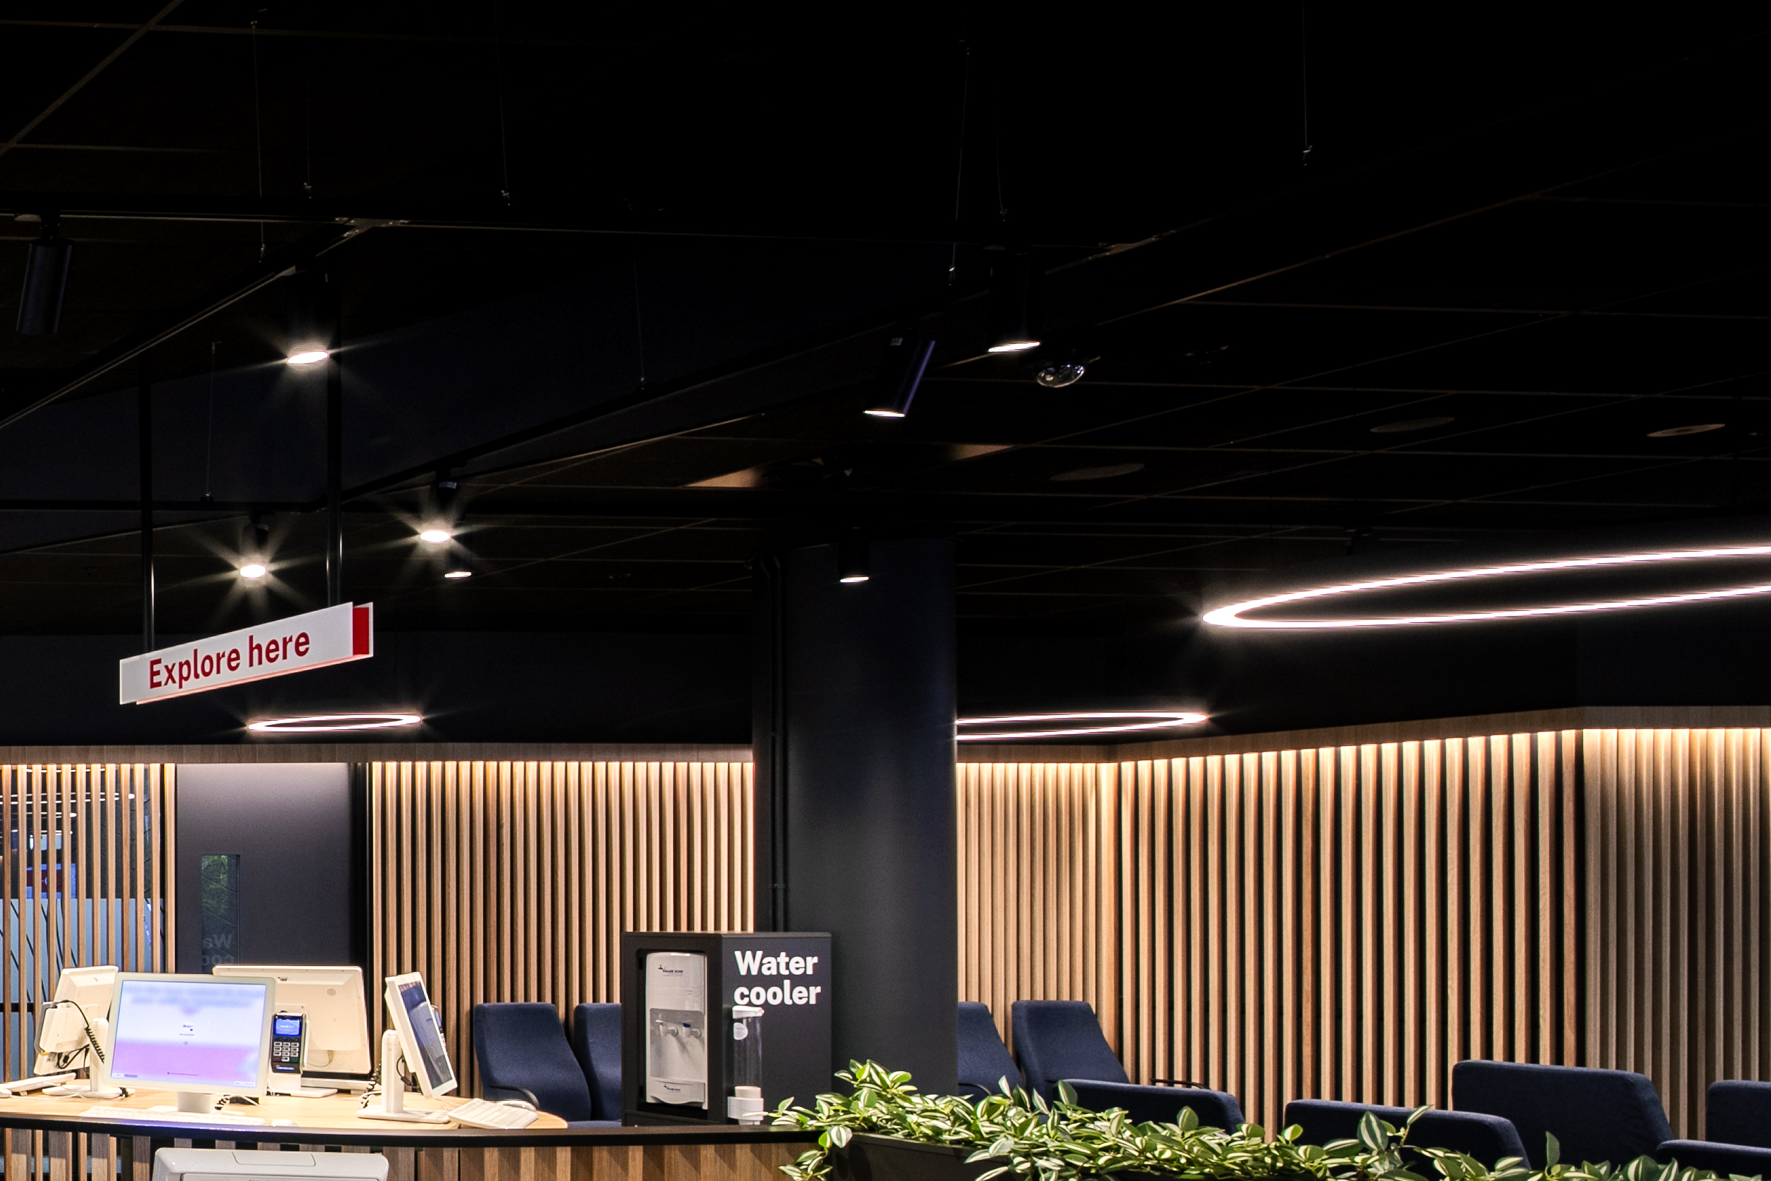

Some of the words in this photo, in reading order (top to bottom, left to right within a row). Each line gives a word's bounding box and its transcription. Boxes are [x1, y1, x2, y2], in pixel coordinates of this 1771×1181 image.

[149, 648, 240, 689] Explore
[248, 632, 310, 667] here
[734, 950, 818, 975] Water
[733, 979, 822, 1005] cooler
